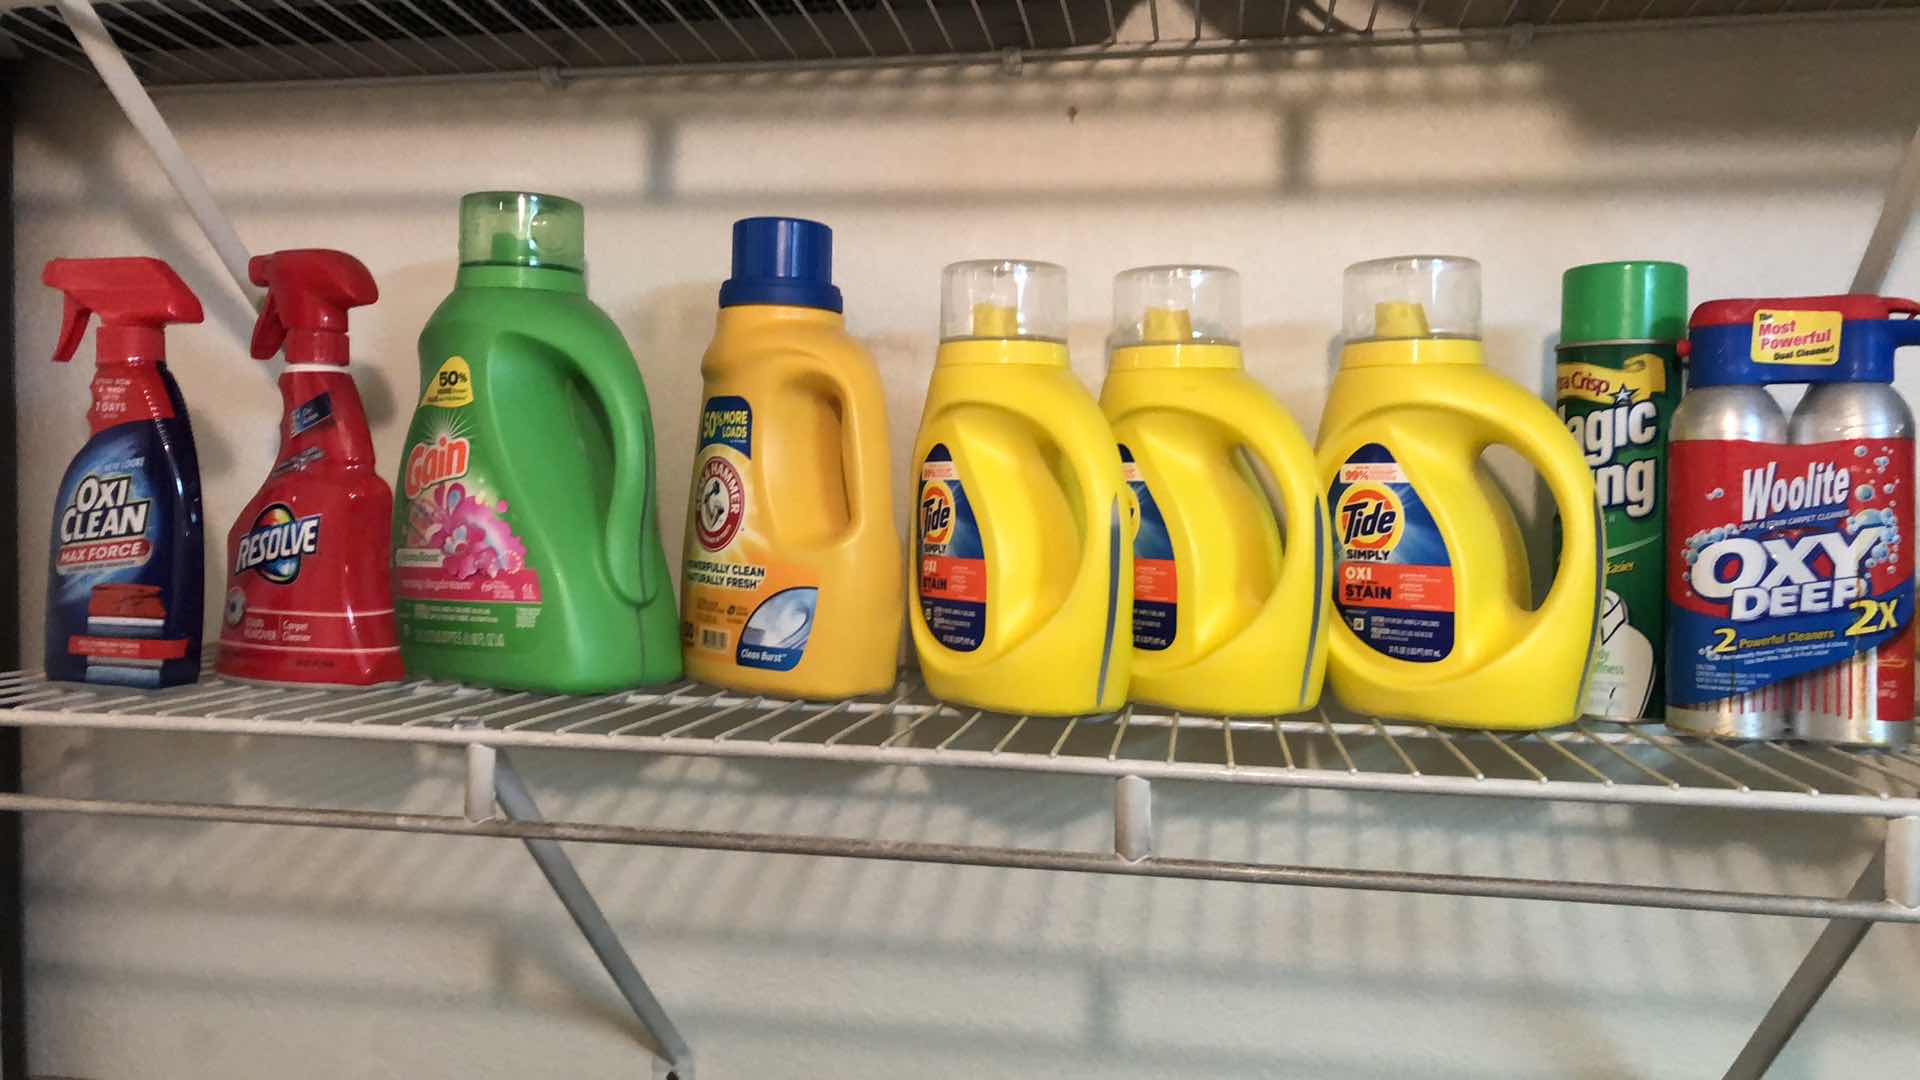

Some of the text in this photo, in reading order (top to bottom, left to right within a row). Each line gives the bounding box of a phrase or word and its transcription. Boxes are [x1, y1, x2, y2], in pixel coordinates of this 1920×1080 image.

[1759, 320, 1796, 337] Most
[1760, 329, 1832, 351] Powerful
[439, 370, 467, 387] 50%
[1571, 371, 1610, 396] Crisp
[723, 411, 748, 425] MORE
[722, 426, 748, 438] LOADS
[1558, 401, 1657, 467] agic
[406, 434, 466, 496] Gain
[76, 476, 130, 513] OXI
[711, 462, 741, 514] HAMMER
[1742, 461, 1850, 521] Woolite
[60, 501, 148, 544] CLEAN
[923, 498, 951, 537] Tide
[1343, 501, 1396, 544] Tide
[61, 541, 142, 561] MAX FORCE
[236, 518, 319, 567] RESOLVE
[1346, 548, 1390, 560] SIMPLY
[732, 565, 765, 577] CLEAN
[923, 559, 937, 575] OXI
[1345, 566, 1372, 581] OXI
[1691, 526, 1884, 599] OXY
[922, 576, 947, 591] STAIN
[1345, 583, 1392, 600] STAIN
[1731, 577, 1868, 622] DEEP
[1845, 599, 1899, 637] 2X
[1713, 628, 1836, 653] 2 Powerful Cleaners
[741, 648, 760, 660] Clean
